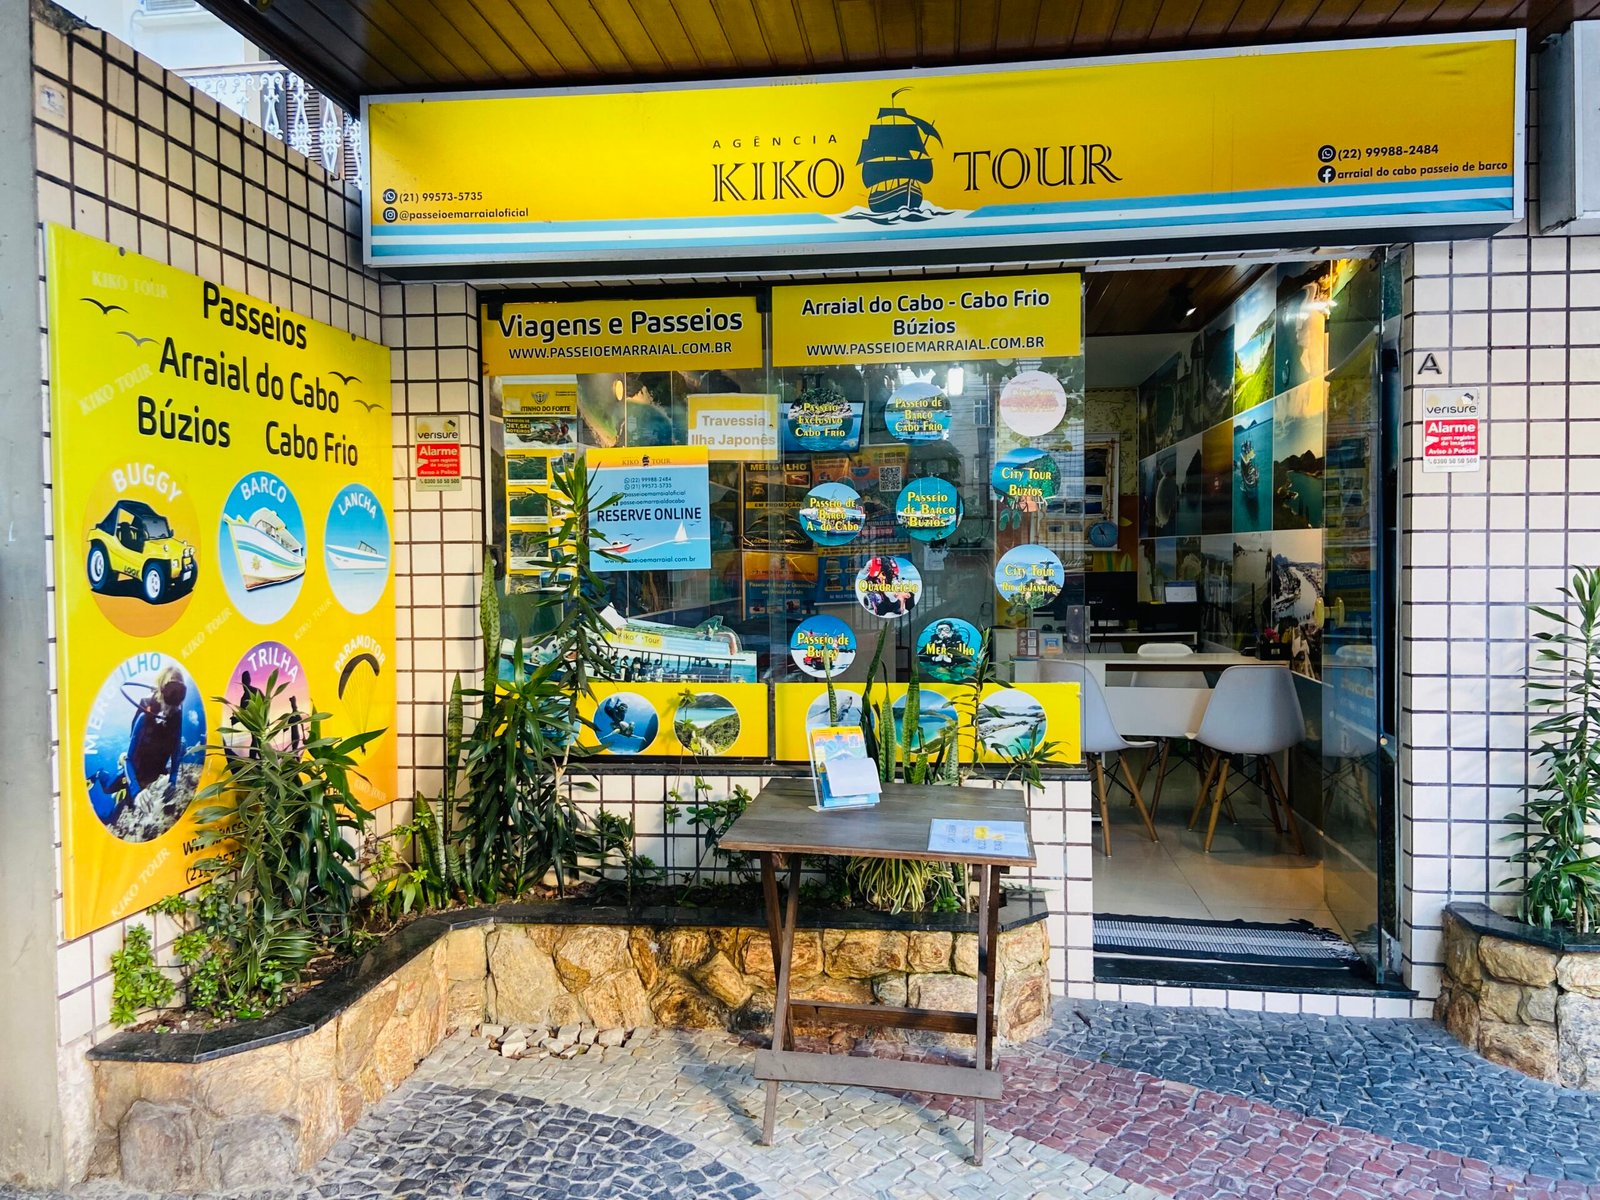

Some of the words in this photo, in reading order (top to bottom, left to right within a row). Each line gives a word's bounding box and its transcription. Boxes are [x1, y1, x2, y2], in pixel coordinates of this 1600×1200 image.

[712, 134, 839, 149] AGÊNCIA
[1337, 146, 1362, 161] (22)
[1364, 143, 1439, 159] 99988-2484
[712, 157, 845, 203] KIKO
[953, 144, 1123, 191] TOUR
[1337, 167, 1373, 180] arraial
[1375, 166, 1389, 178] do
[1391, 165, 1417, 177] cabo
[1420, 164, 1459, 178] passeio
[1461, 162, 1475, 174] de
[1478, 161, 1508, 173] barco
[398, 190, 419, 204] (21)
[422, 190, 483, 203] 99573-5735
[398, 207, 529, 221] @passeioemarraialoficial
[91, 270, 129, 292] KIKO
[801, 297, 865, 316] Arraial
[869, 296, 892, 313] do
[897, 293, 944, 312] Cabo
[960, 290, 1008, 310] Cabo
[1014, 288, 1050, 307] Frio
[203, 280, 307, 350] Passeios
[498, 314, 602, 343] Viagens
[608, 315, 623, 334] e
[631, 308, 743, 335] Passeios
[893, 317, 956, 336] Búzios
[508, 341, 732, 360] WWW.PASSEIOEMARRAIAL.COM.BR
[806, 336, 1045, 357] WWW.PASSEIOEMARRAIAL.COM.BR
[1417, 352, 1442, 375] A
[159, 336, 250, 394] Arraial
[255, 362, 284, 401] do
[290, 372, 339, 414] Cabo
[1426, 404, 1477, 414] verisure
[701, 414, 766, 427] Travessia
[1427, 421, 1476, 434] Alarme
[137, 394, 231, 448] Búzios
[265, 420, 318, 461] Cabo
[324, 432, 358, 467] Frio
[417, 431, 459, 440] verisure
[691, 432, 716, 446] Ilha
[717, 431, 776, 448] Japonês
[419, 445, 458, 456] Alarme
[1428, 447, 1447, 455] Aviso
[110, 462, 183, 503] BUGGY
[240, 479, 287, 504] BARCO
[624, 490, 687, 498] passeioemarraialoficial
[338, 492, 377, 519] LANCHA
[596, 508, 652, 522] RESERVE
[654, 507, 702, 521] ONLINE
[333, 634, 386, 674] PARAMOTOR
[926, 642, 975, 658] Merglho
[247, 647, 298, 684] TRILHA
